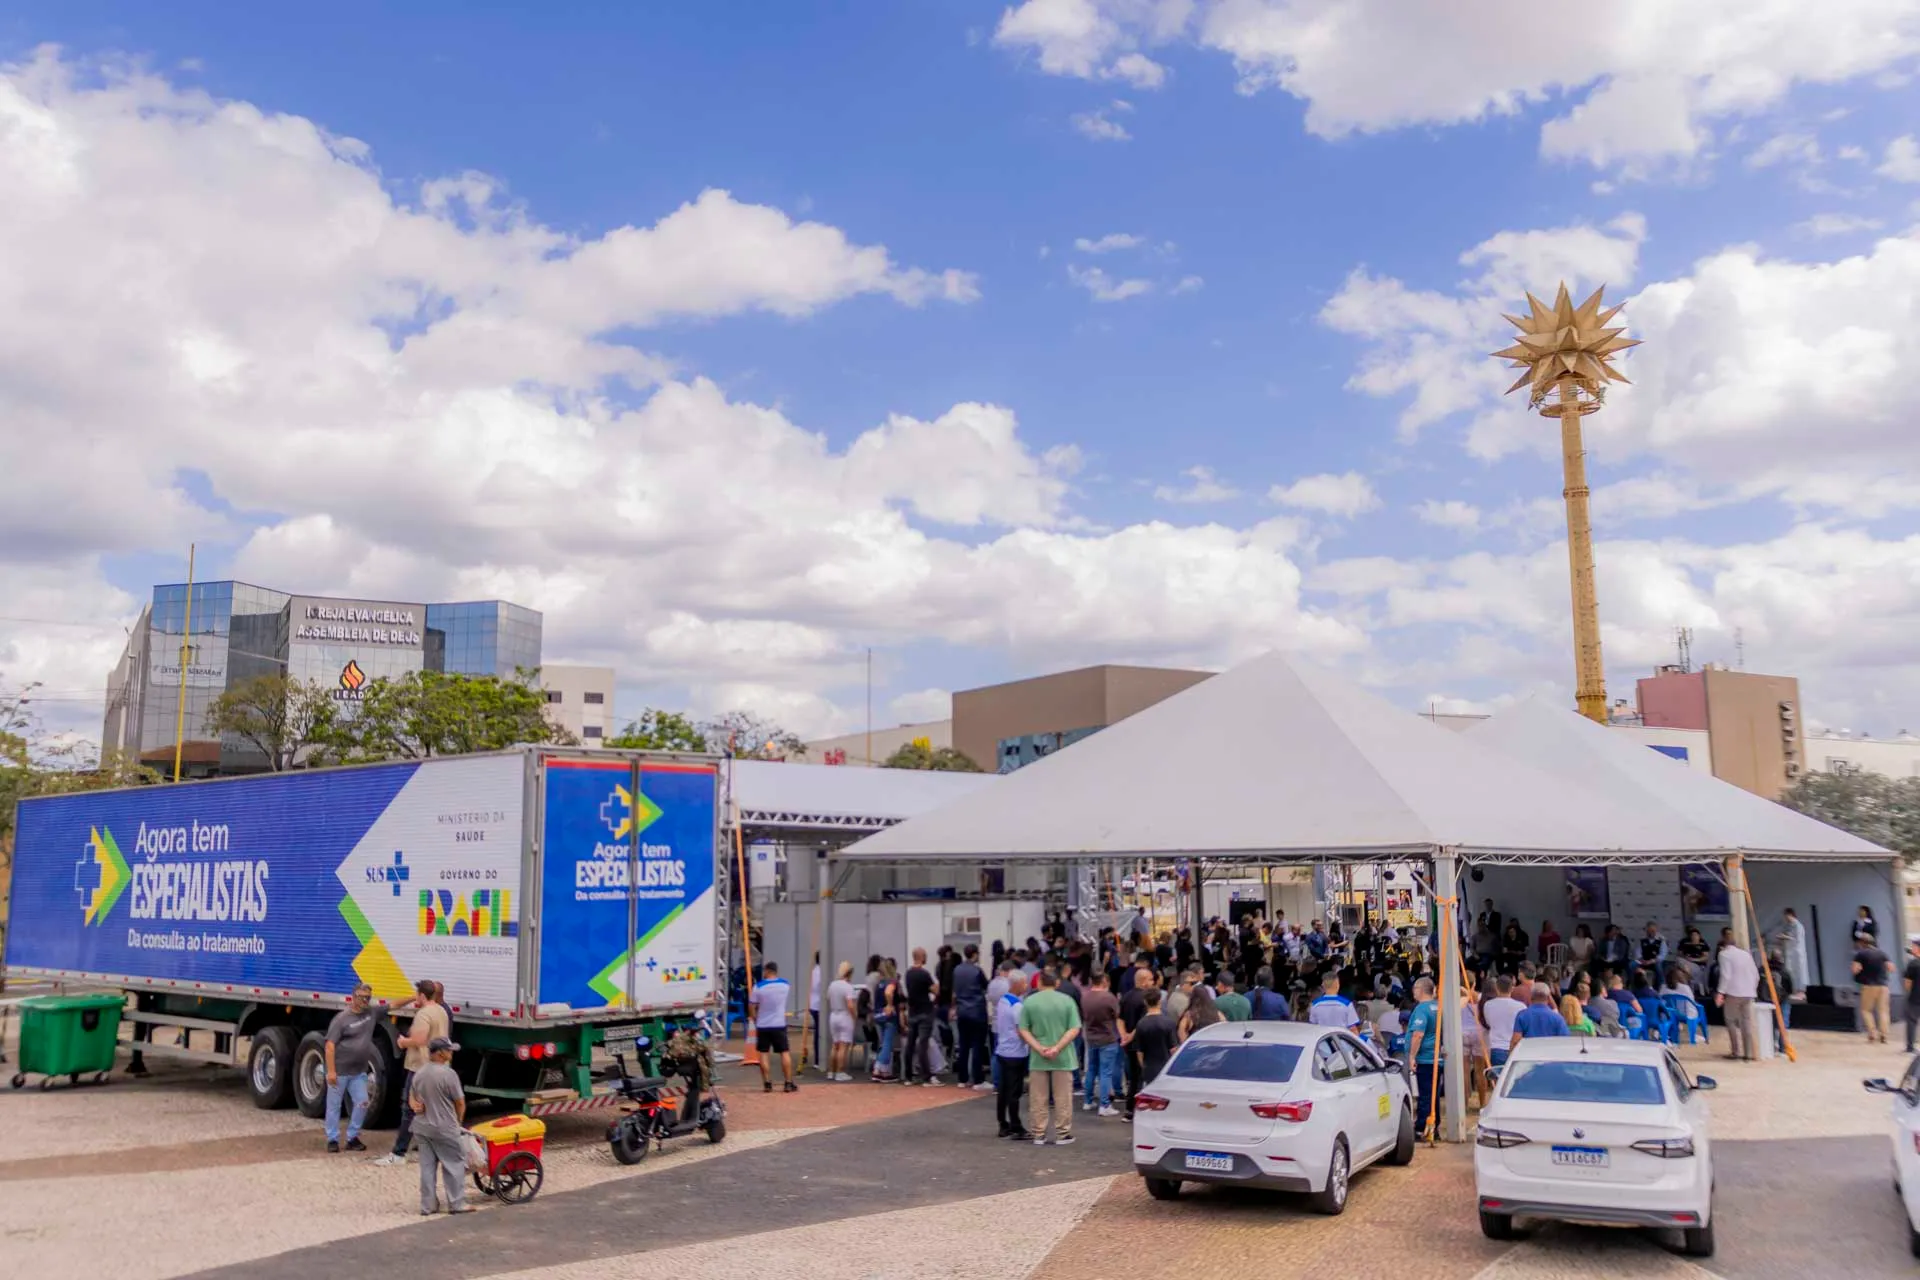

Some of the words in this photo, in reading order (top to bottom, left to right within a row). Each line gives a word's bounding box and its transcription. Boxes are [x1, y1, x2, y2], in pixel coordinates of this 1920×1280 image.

[297, 624, 369, 640] ASSEMBLEIA
[372, 629, 388, 641] DE
[390, 630, 419, 643] DEUS
[135, 821, 187, 862] Agora
[192, 819, 228, 851] tem
[593, 842, 630, 860] Agor
[642, 842, 672, 857] tem
[366, 867, 385, 882] SUS
[440, 870, 480, 880] GOVERNO
[486, 870, 498, 879] DO
[130, 860, 269, 922] ESPECIALISTAS
[418, 889, 518, 937] BRASIL
[128, 928, 141, 947] Da
[143, 929, 185, 949] consulta
[187, 933, 201, 950] ao
[202, 932, 265, 954] tratamento
